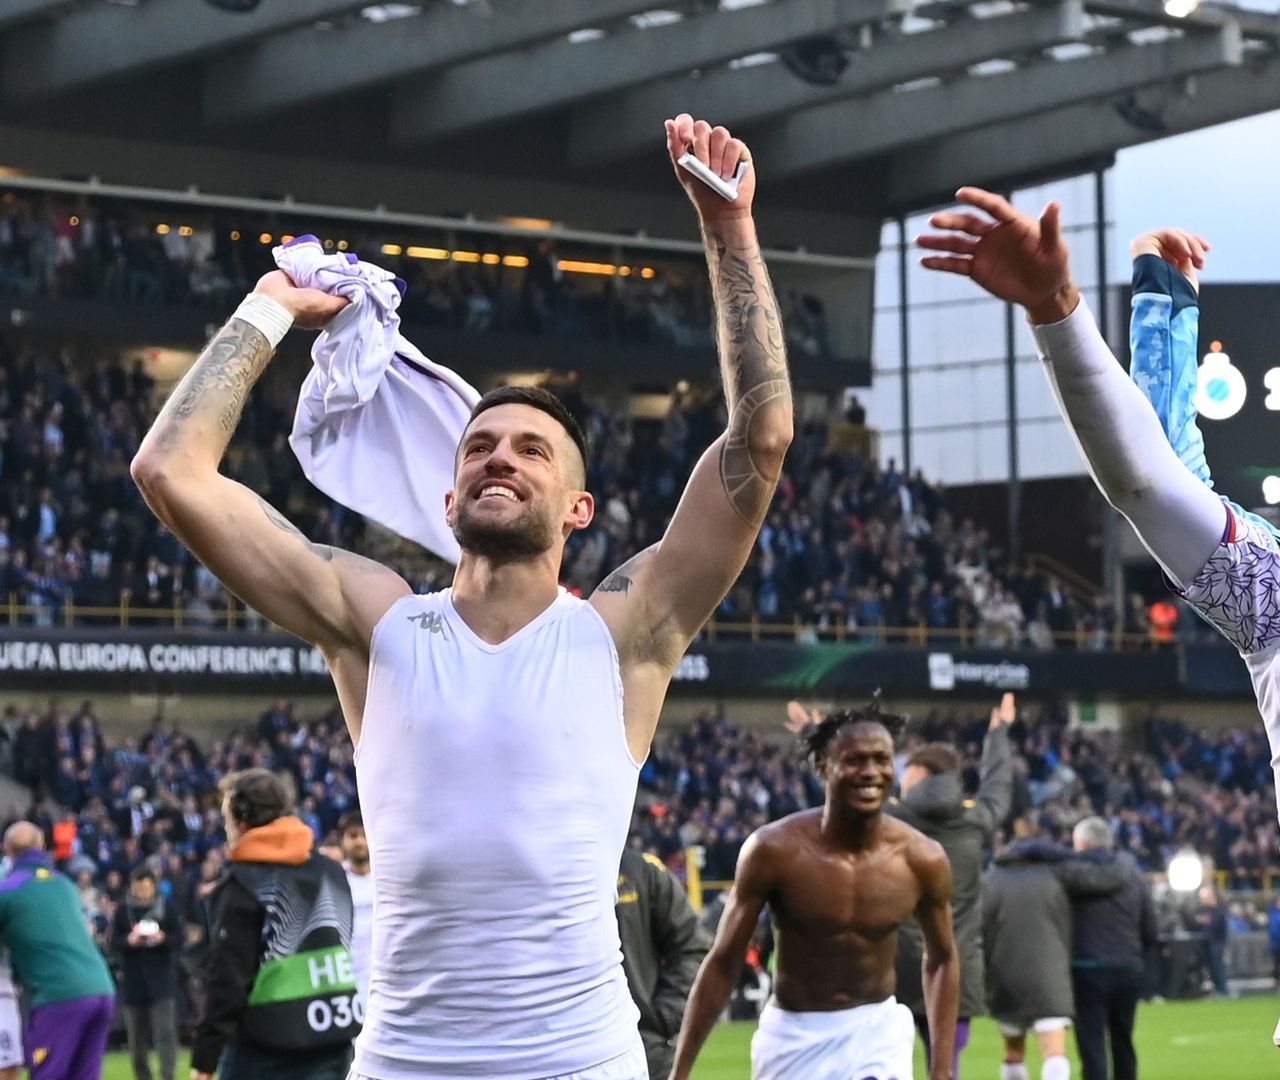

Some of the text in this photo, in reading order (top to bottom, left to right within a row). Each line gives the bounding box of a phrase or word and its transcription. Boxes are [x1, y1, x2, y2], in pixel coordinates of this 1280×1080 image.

[59, 643, 148, 671] EUROPA
[150, 644, 295, 674] CONFERENCE
[307, 993, 365, 1033] 030
